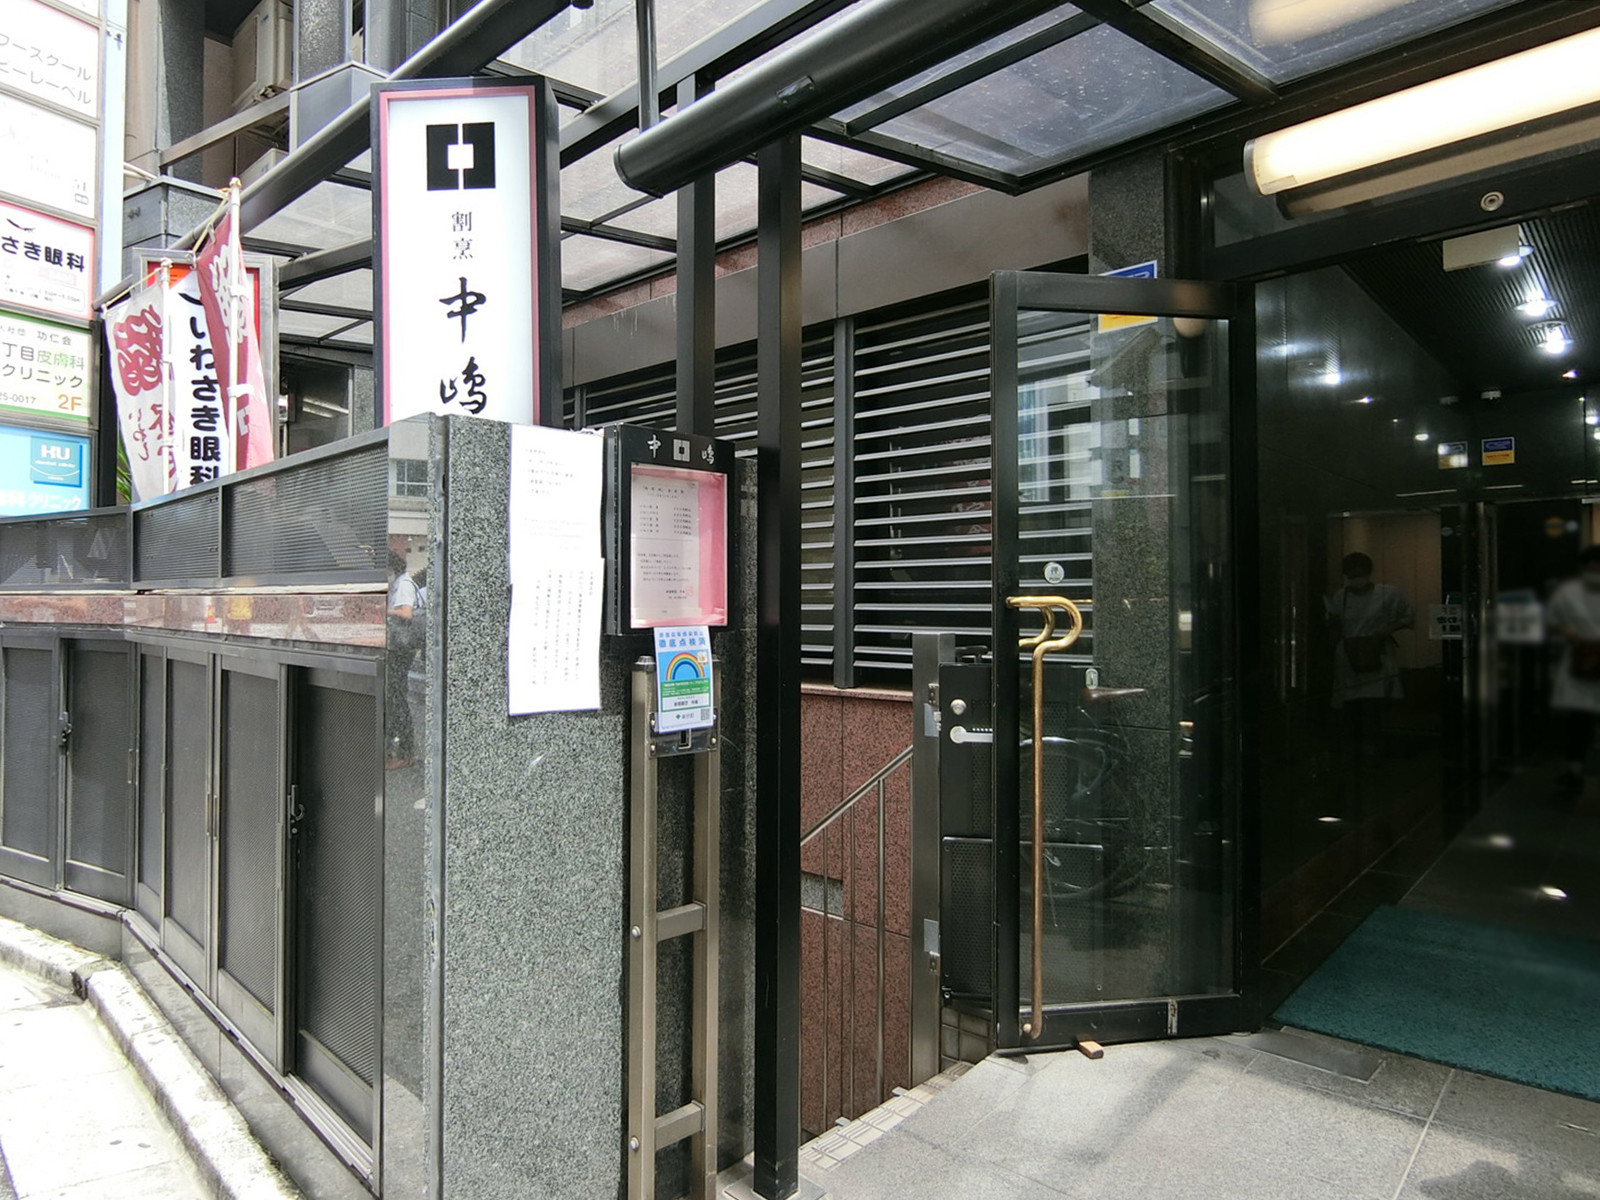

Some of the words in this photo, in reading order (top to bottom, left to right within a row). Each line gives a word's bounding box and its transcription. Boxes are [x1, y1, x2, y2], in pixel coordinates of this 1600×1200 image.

[451, 211, 473, 260] 割烹
[1, 235, 85, 272] さき眼科
[2, 342, 84, 370] 丁目皮膚科
[438, 276, 487, 415] 中嶋
[2, 364, 83, 388] クリニック
[58, 394, 82, 411] 2F
[647, 434, 661, 459] 中
